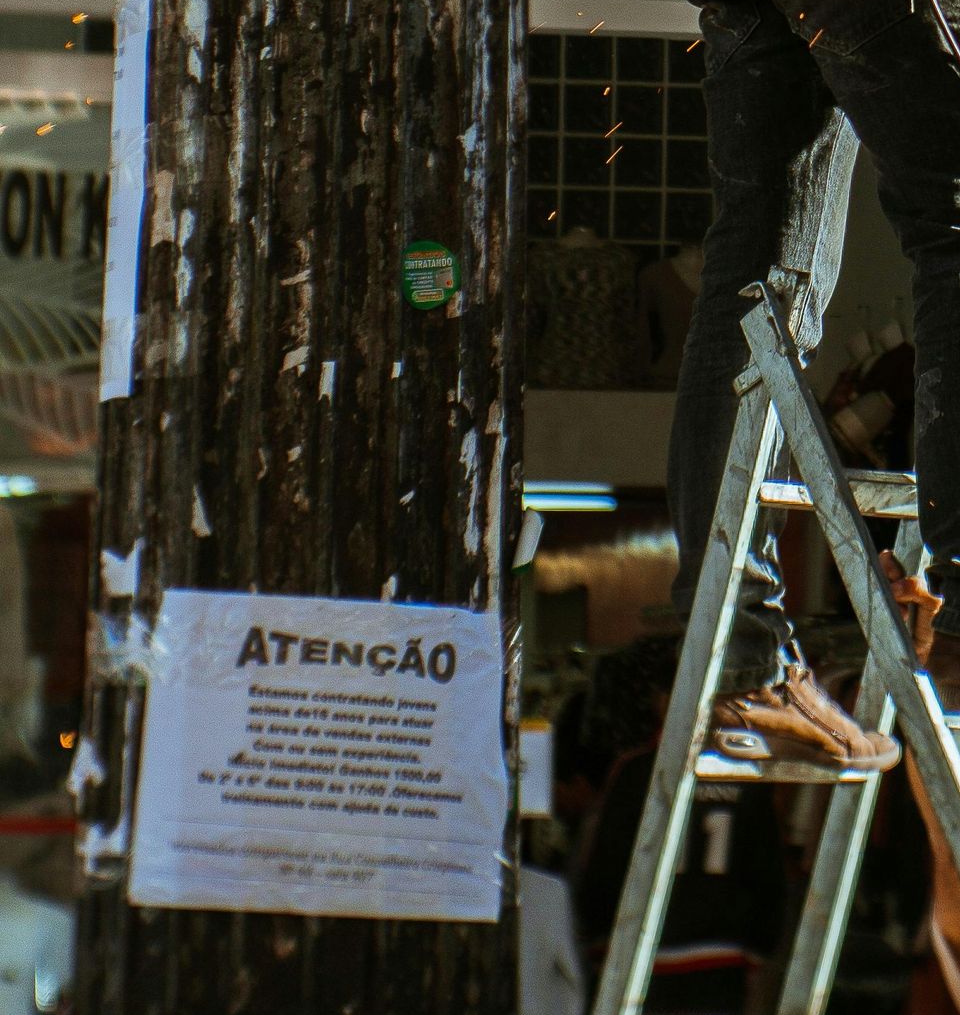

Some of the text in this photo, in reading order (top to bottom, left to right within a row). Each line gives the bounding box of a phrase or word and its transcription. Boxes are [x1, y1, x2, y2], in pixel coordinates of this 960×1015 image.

[235, 625, 457, 684] ATENÇÃO
[311, 688, 395, 707] contratando
[397, 697, 438, 712] jovens
[368, 713, 400, 726] para
